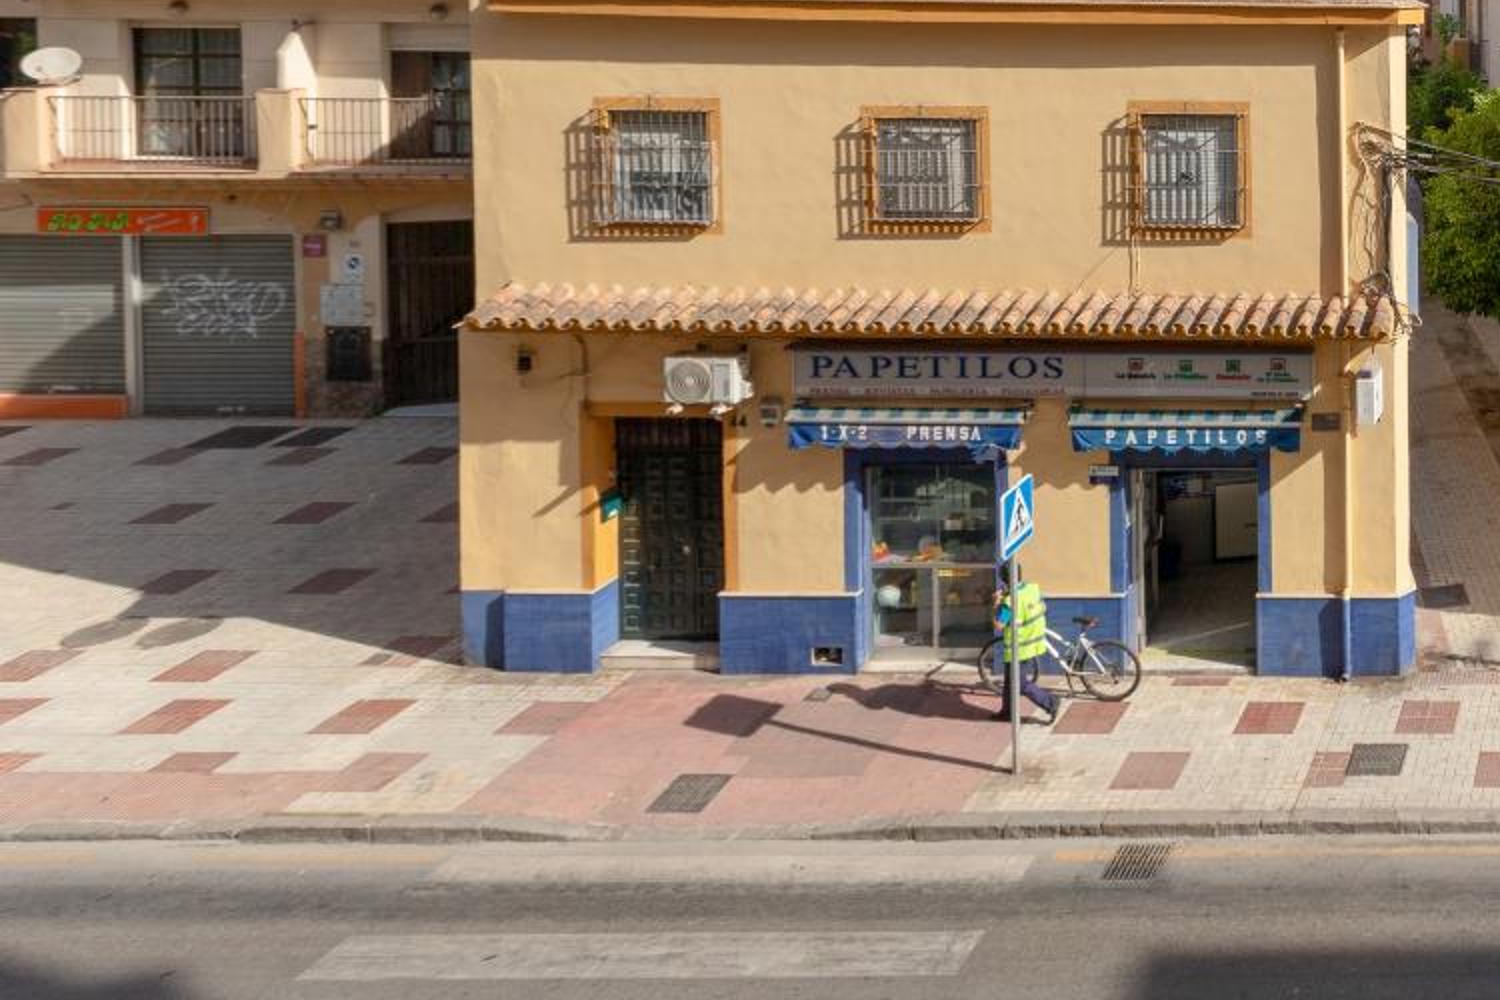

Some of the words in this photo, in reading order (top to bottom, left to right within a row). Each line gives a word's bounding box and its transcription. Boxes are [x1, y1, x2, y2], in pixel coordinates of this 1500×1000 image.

[809, 355, 1064, 379] PAPETILOS
[906, 425, 981, 441] PRENSA
[1105, 429, 1268, 445] PAPETILOS
